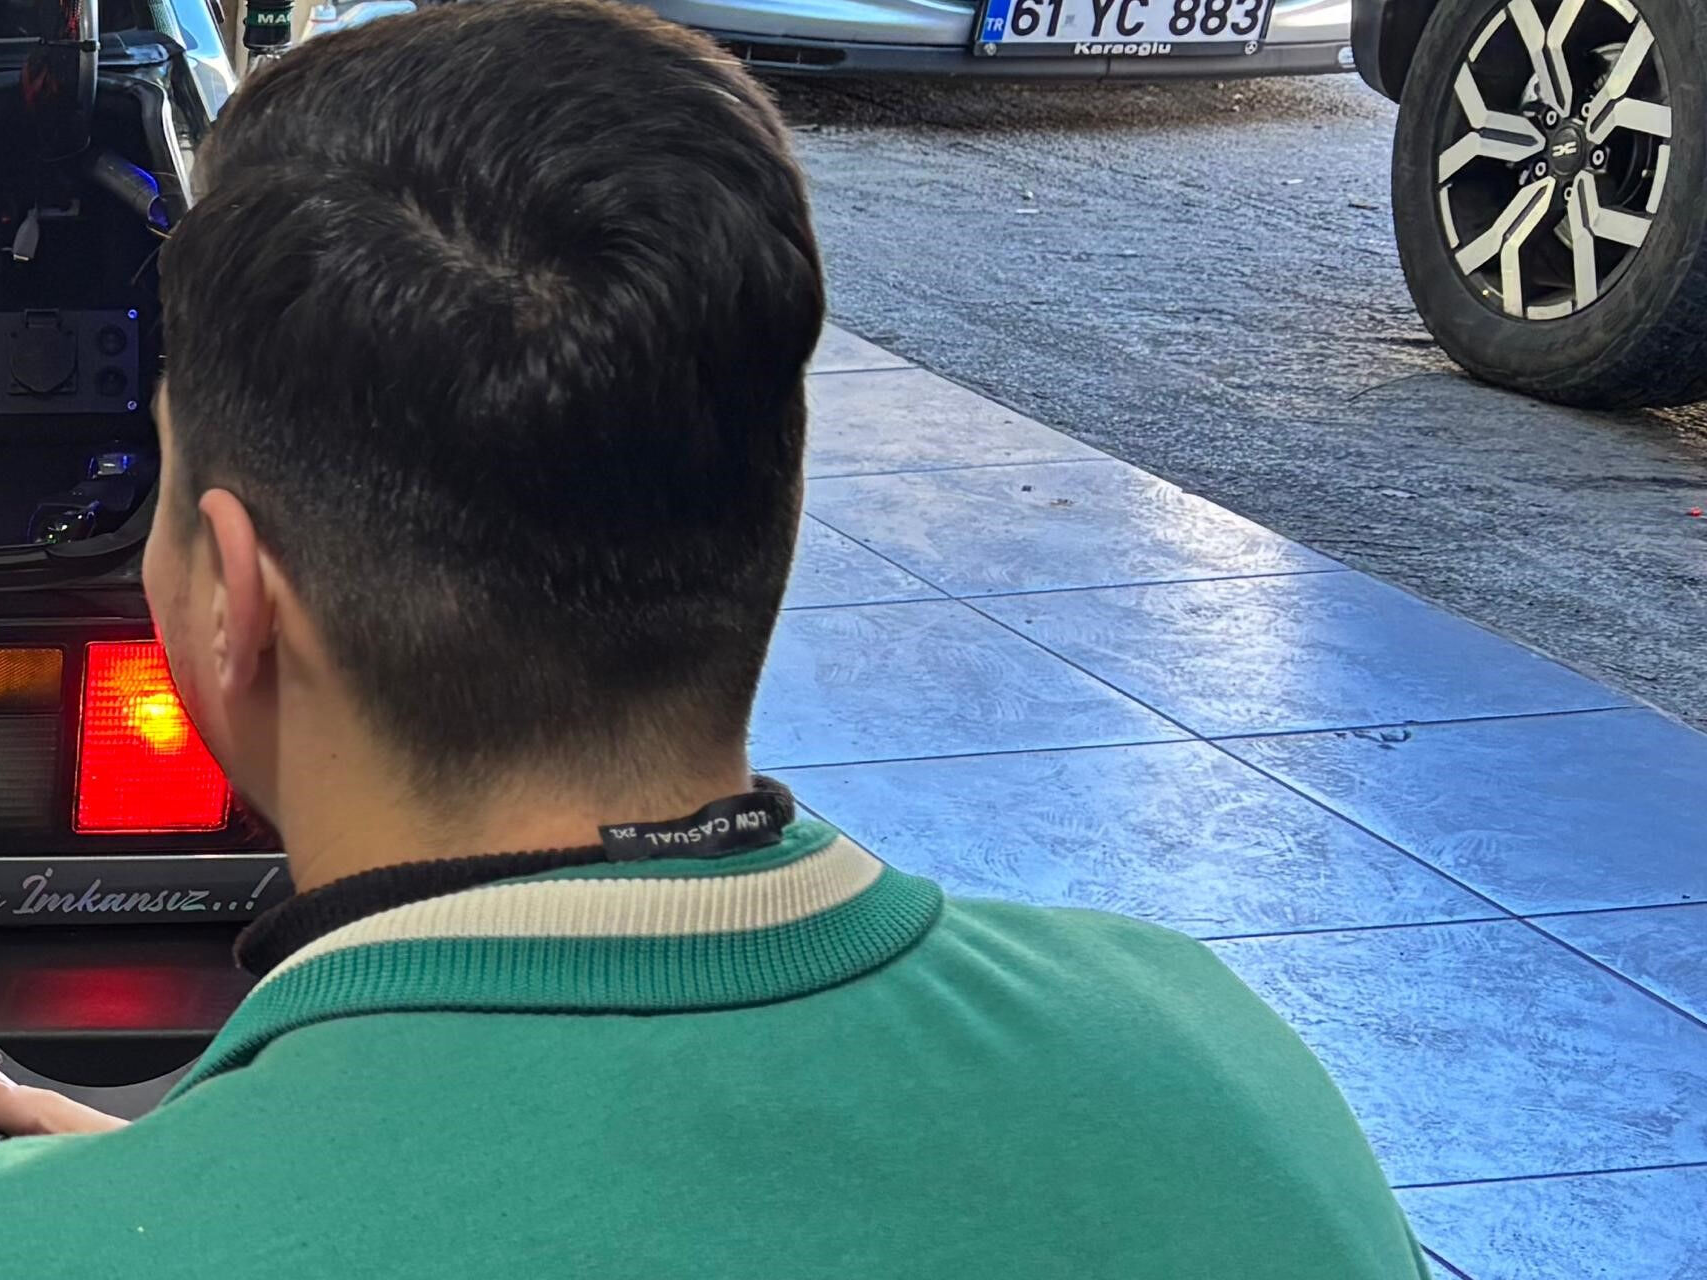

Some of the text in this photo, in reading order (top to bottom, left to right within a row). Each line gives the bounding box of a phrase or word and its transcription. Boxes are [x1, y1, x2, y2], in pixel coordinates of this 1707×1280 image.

[986, 18, 1004, 32] TR
[609, 826, 637, 839] 2XL
[645, 817, 730, 846] CASUAL
